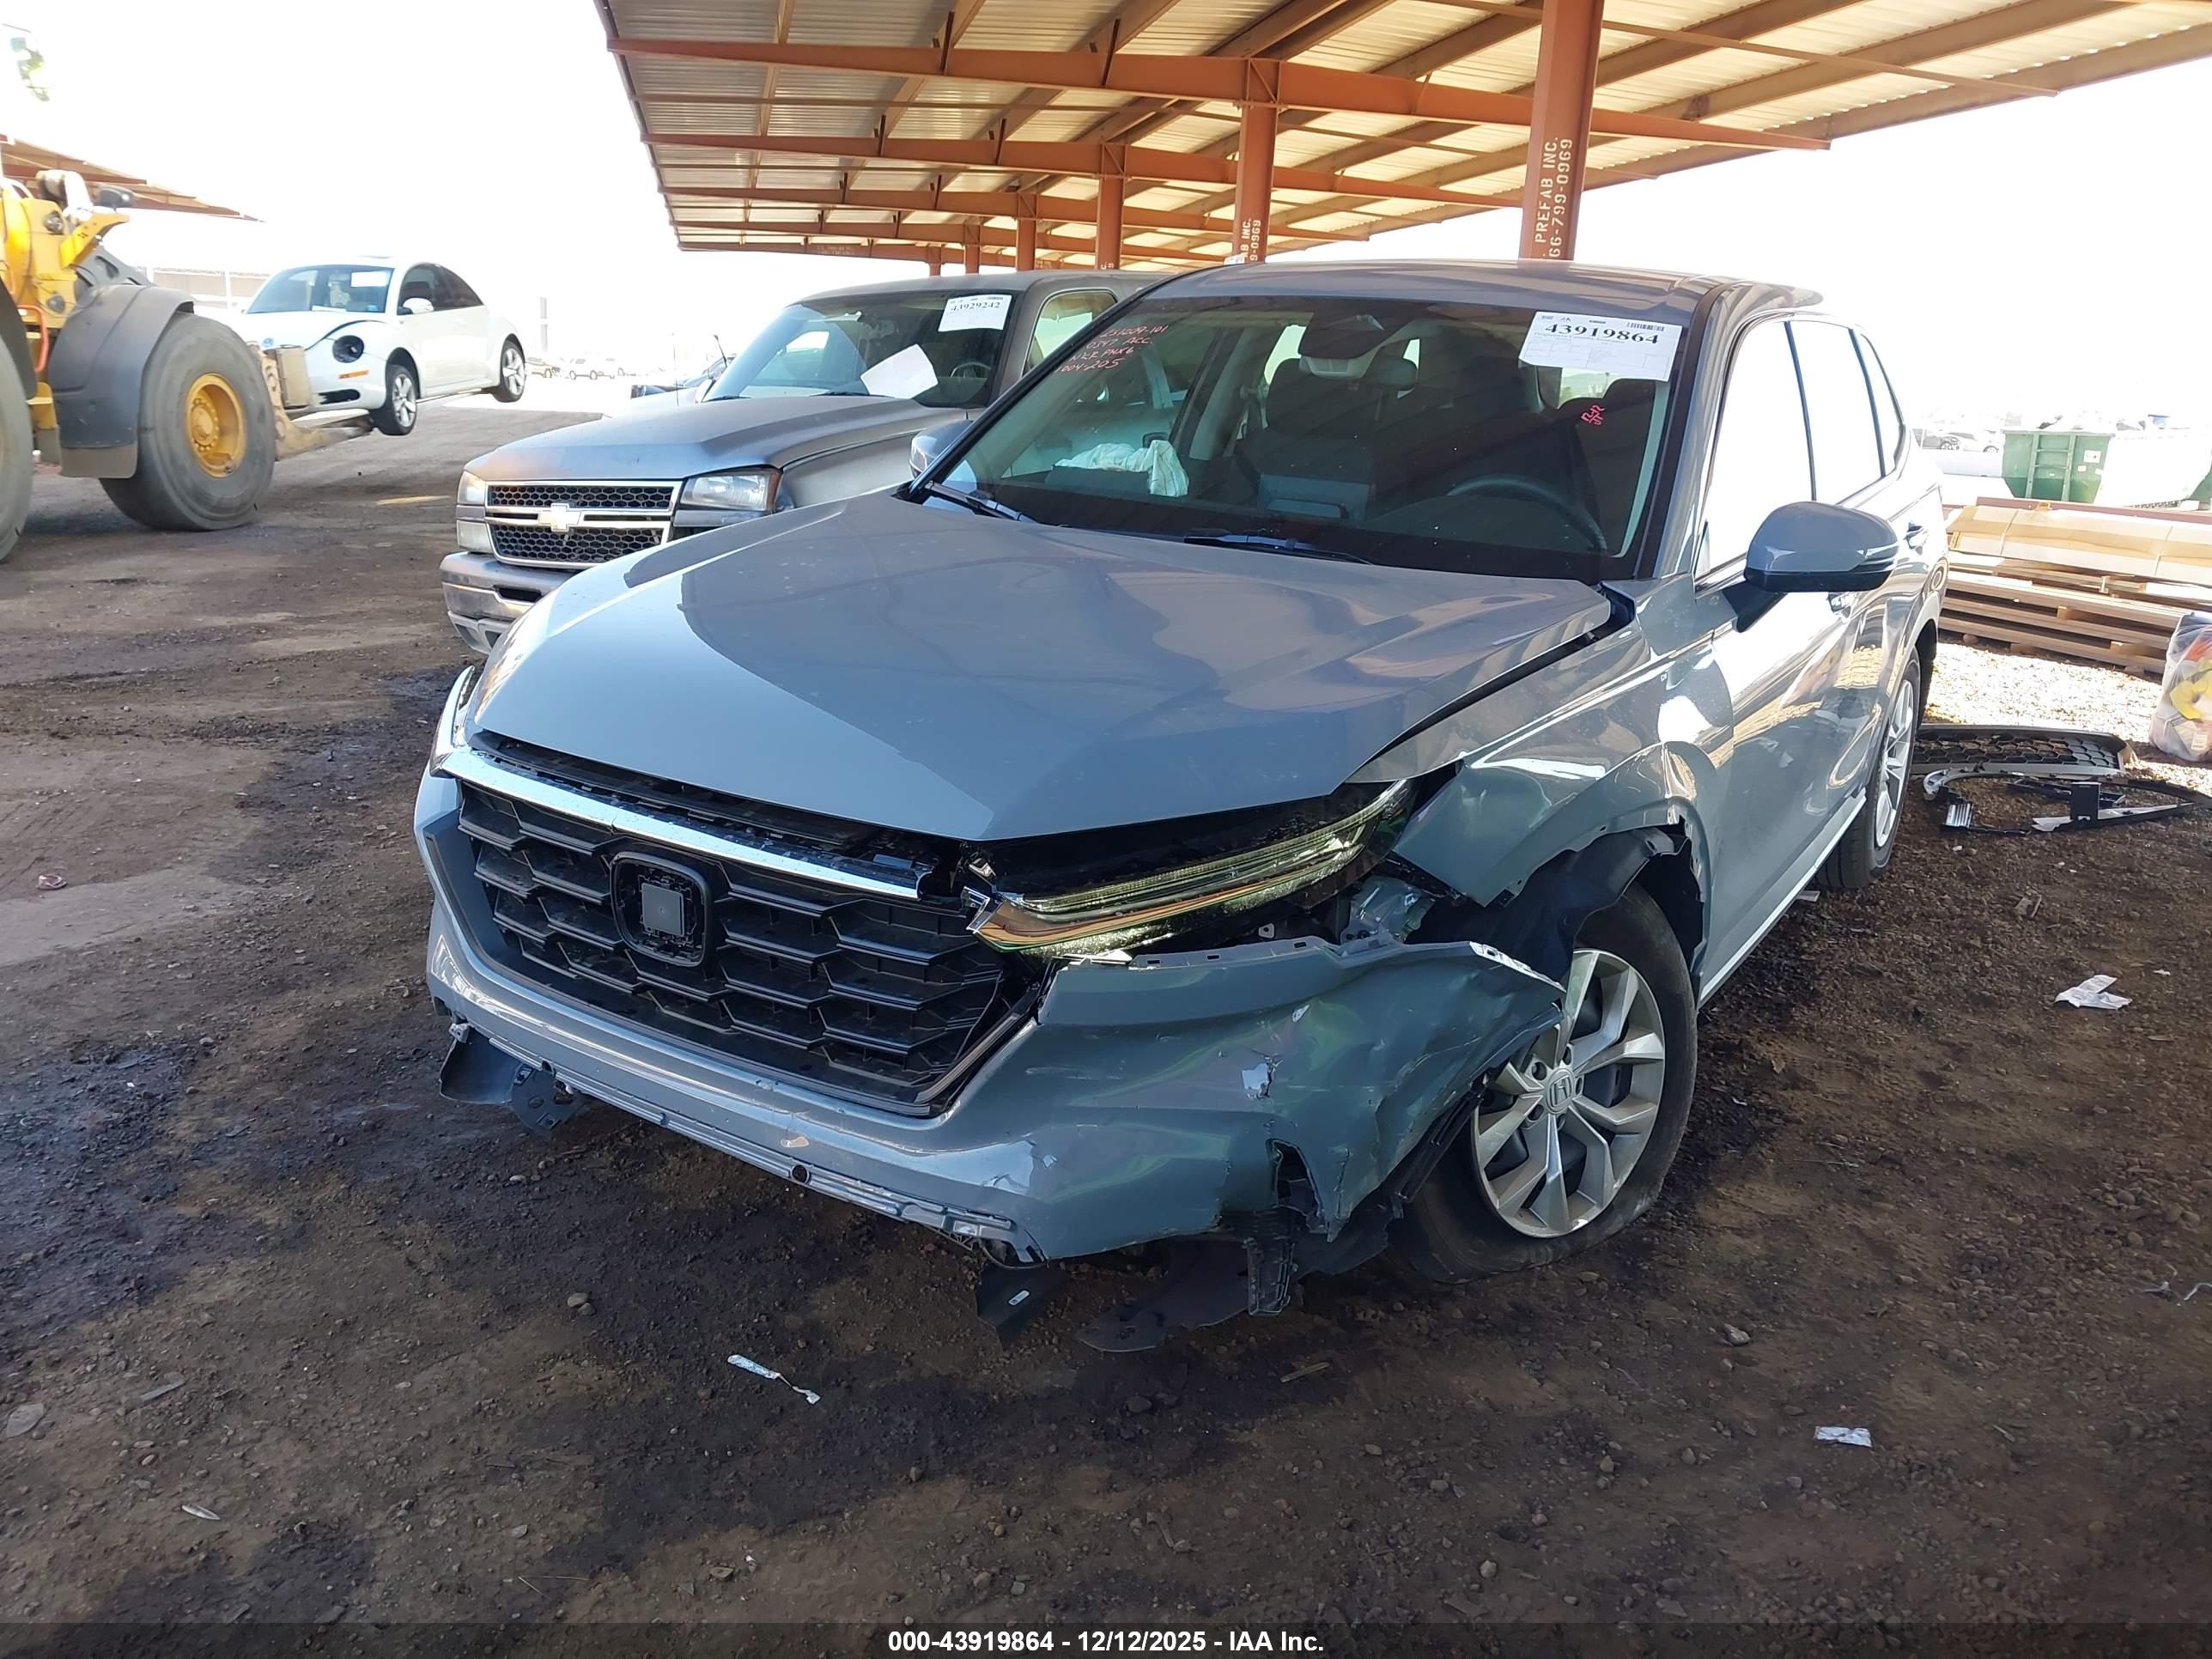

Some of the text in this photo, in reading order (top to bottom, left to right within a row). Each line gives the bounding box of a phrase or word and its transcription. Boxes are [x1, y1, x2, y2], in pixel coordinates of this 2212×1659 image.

[1534, 137, 1559, 243] PREFAB INC.
[1545, 322, 1660, 344] 43919864
